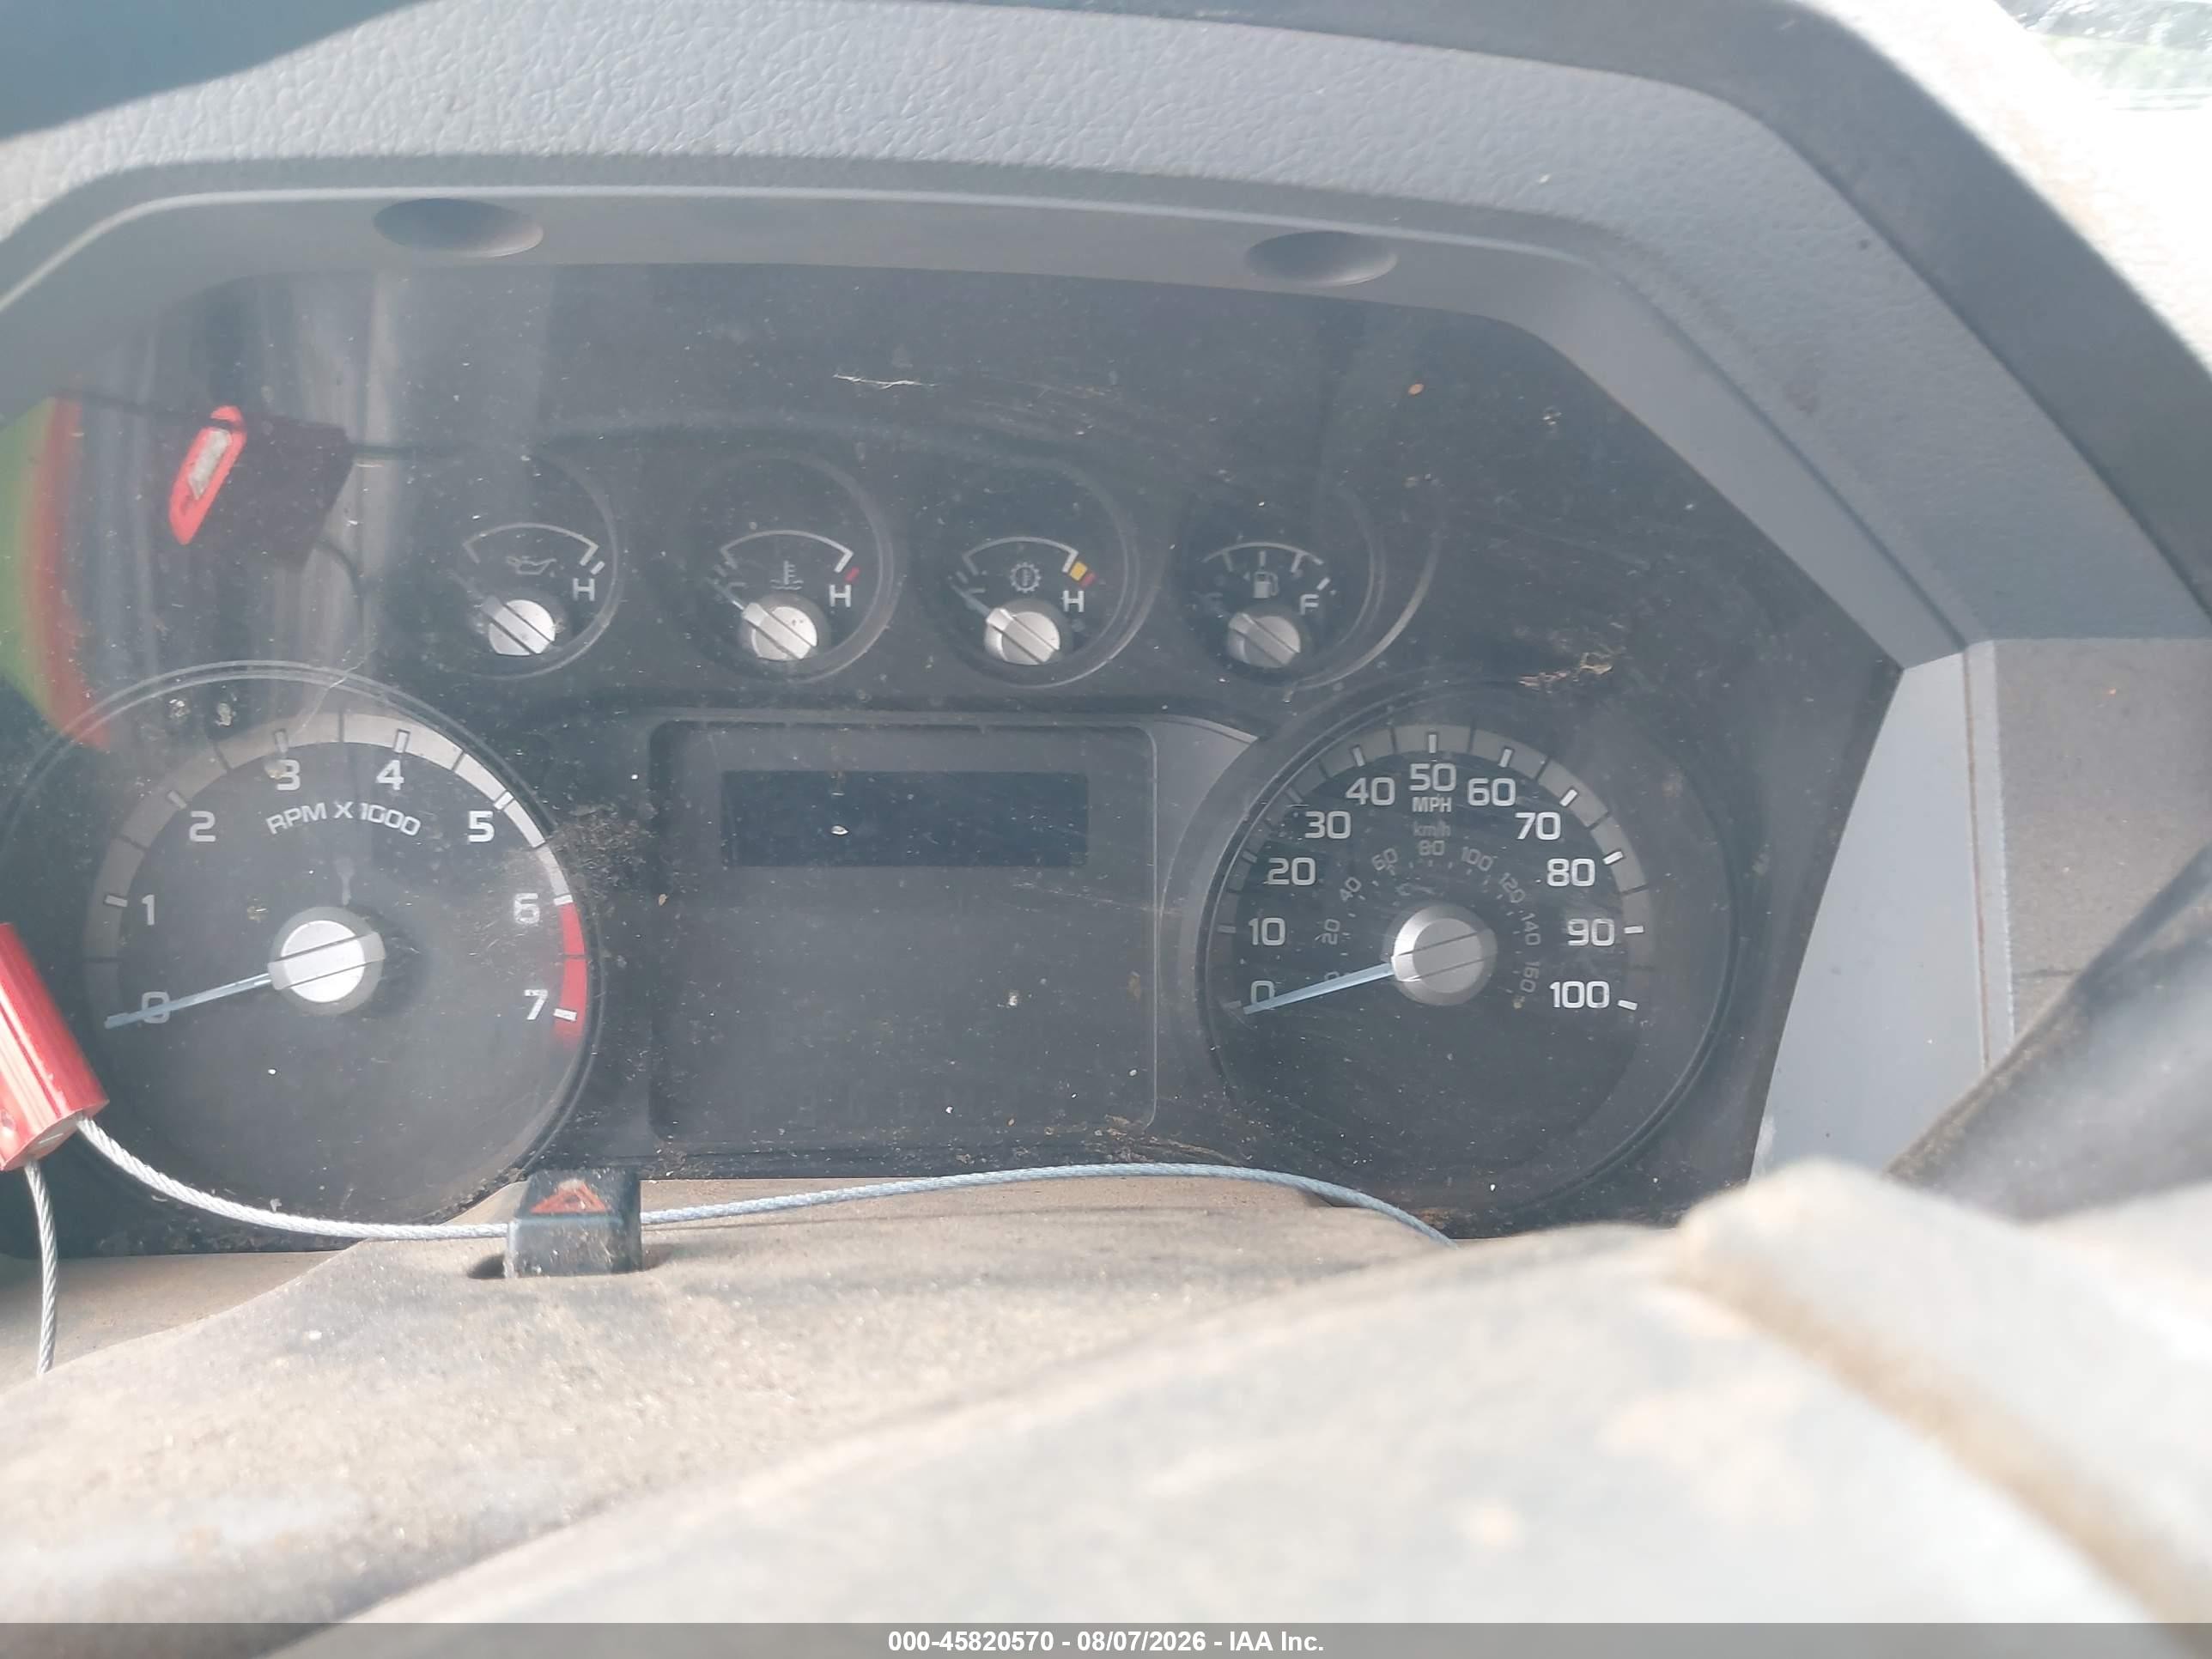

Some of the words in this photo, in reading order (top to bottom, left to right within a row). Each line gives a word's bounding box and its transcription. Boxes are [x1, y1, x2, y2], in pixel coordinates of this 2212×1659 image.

[572, 577, 595, 602] H
[830, 584, 852, 608] H
[1062, 590, 1085, 613] H
[1300, 593, 1320, 616] F
[275, 760, 301, 791] 3
[376, 760, 405, 791] 4
[1408, 763, 1457, 793] 50
[1345, 778, 1396, 806] 40
[1413, 796, 1453, 813] MPH
[1467, 778, 1517, 807] 60
[189, 811, 216, 843] 2
[266, 801, 328, 836] RPM
[333, 801, 355, 819] X
[359, 802, 422, 837] 1000
[468, 811, 495, 843] 5
[1304, 811, 1352, 840] 30
[1413, 820, 1452, 838] km/h
[1515, 811, 1562, 842] 70
[1370, 848, 1399, 872] 60
[1418, 840, 1445, 856] 80
[1460, 846, 1494, 872] 100
[1267, 856, 1316, 887] 20
[1547, 857, 1596, 888] 80
[1339, 876, 1362, 902] 40
[1498, 872, 1526, 904] 120
[141, 895, 156, 926] 1
[514, 892, 539, 925] 6
[1248, 917, 1286, 946] 10
[1321, 918, 1340, 945] 20
[1521, 912, 1541, 946] 140
[1566, 918, 1616, 948] 90
[1520, 961, 1540, 994] 160
[141, 990, 171, 1024] 0
[523, 988, 550, 1021] 7
[1250, 980, 1276, 1006] 0
[1549, 980, 1610, 1010] 100
